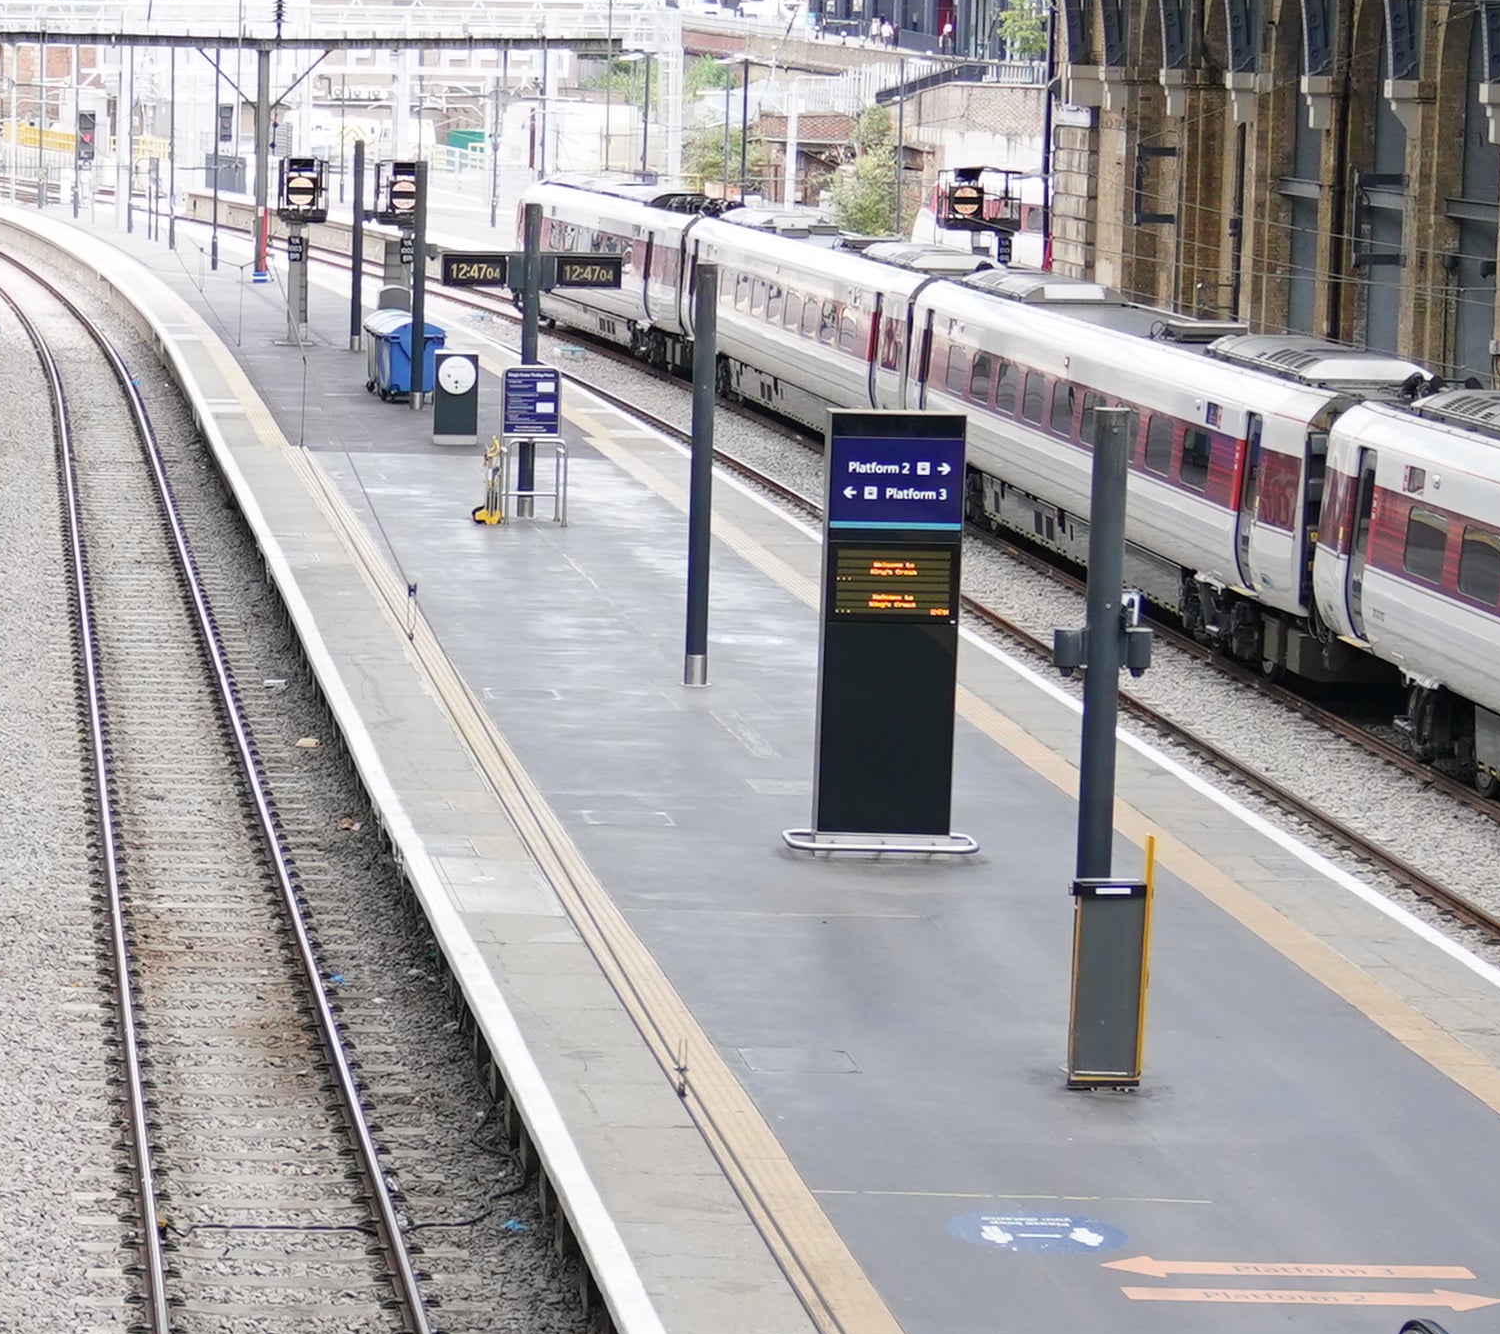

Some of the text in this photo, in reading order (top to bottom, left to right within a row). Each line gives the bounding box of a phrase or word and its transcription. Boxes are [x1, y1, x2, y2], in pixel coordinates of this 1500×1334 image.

[848, 461, 910, 474] Platform 2
[885, 487, 947, 500] Platform 3
[1233, 1265, 1396, 1276] Platform 3
[1203, 1290, 1366, 1302] Platform 2
